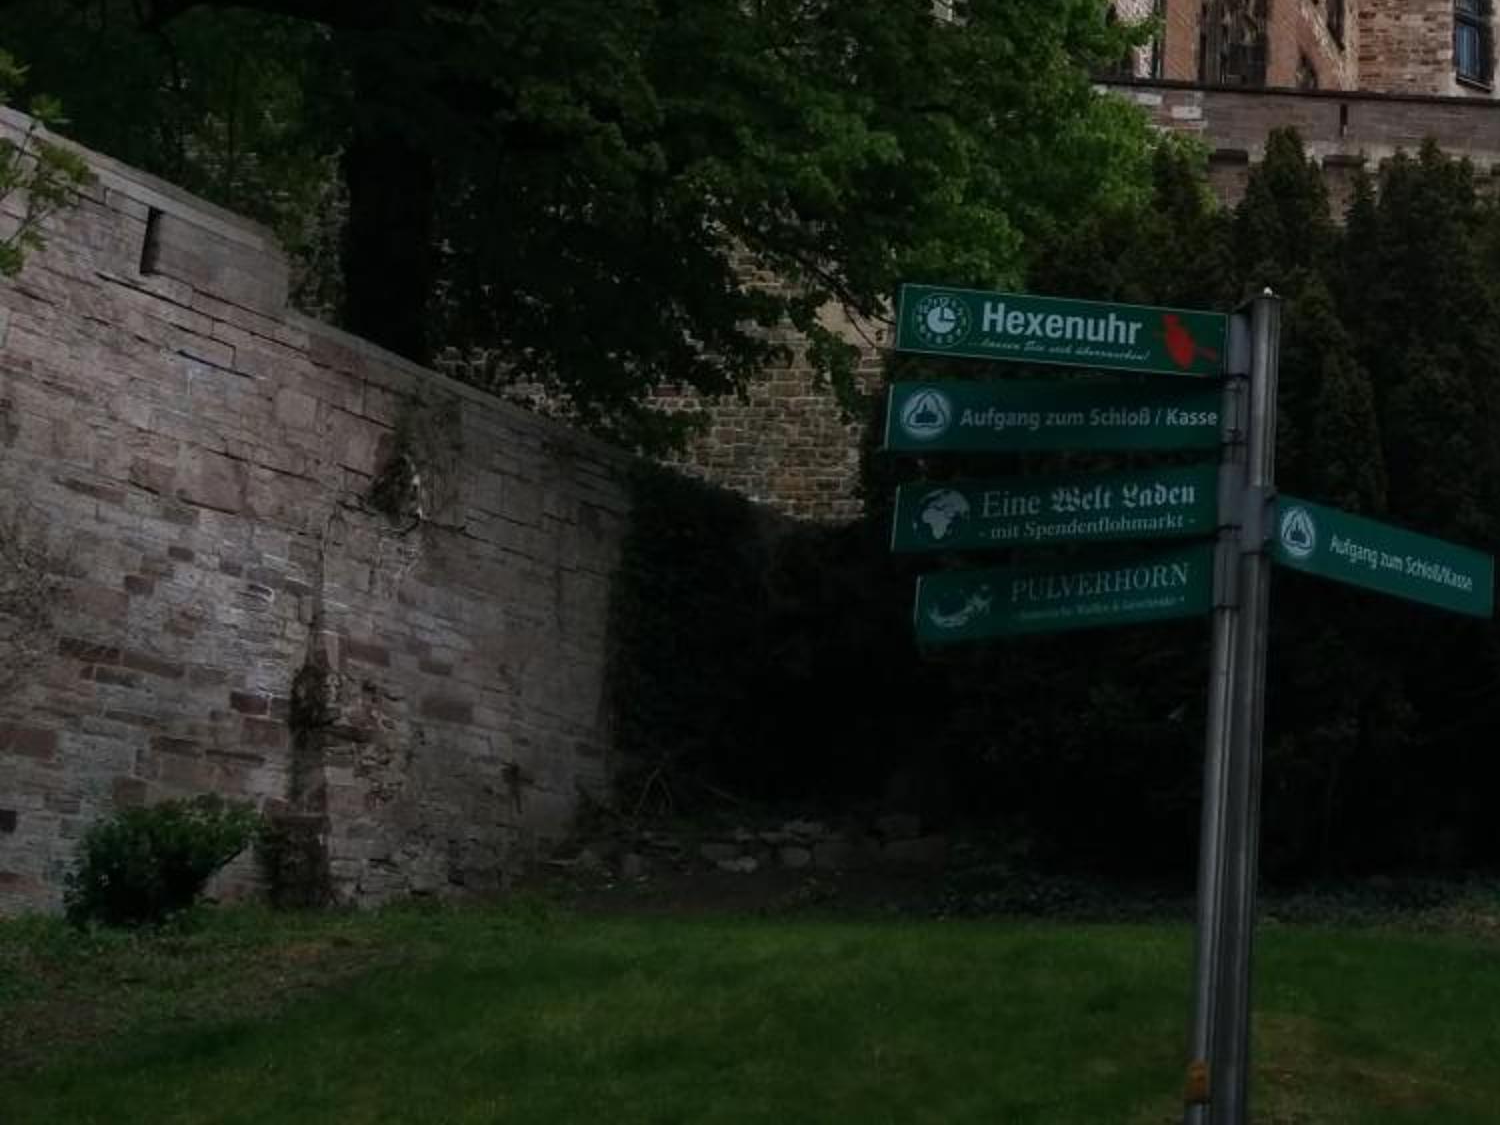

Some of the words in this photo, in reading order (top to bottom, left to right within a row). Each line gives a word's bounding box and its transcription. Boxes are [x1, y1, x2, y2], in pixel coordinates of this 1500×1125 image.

[982, 301, 1143, 345] Hexenuhr
[960, 407, 1040, 431] Aufgang
[1045, 411, 1084, 426] zum
[1089, 406, 1150, 426] Schloß
[1165, 407, 1218, 427] Kasse
[982, 490, 1041, 518] Eine
[1051, 484, 1112, 513] Welt
[1121, 482, 1196, 509] Laden
[991, 522, 1019, 539] mit
[1024, 513, 1184, 540] Spendenflohmarkt
[1329, 533, 1378, 570] Aufgang
[1380, 552, 1404, 572] zum
[1010, 562, 1190, 603] PULVERHORN
